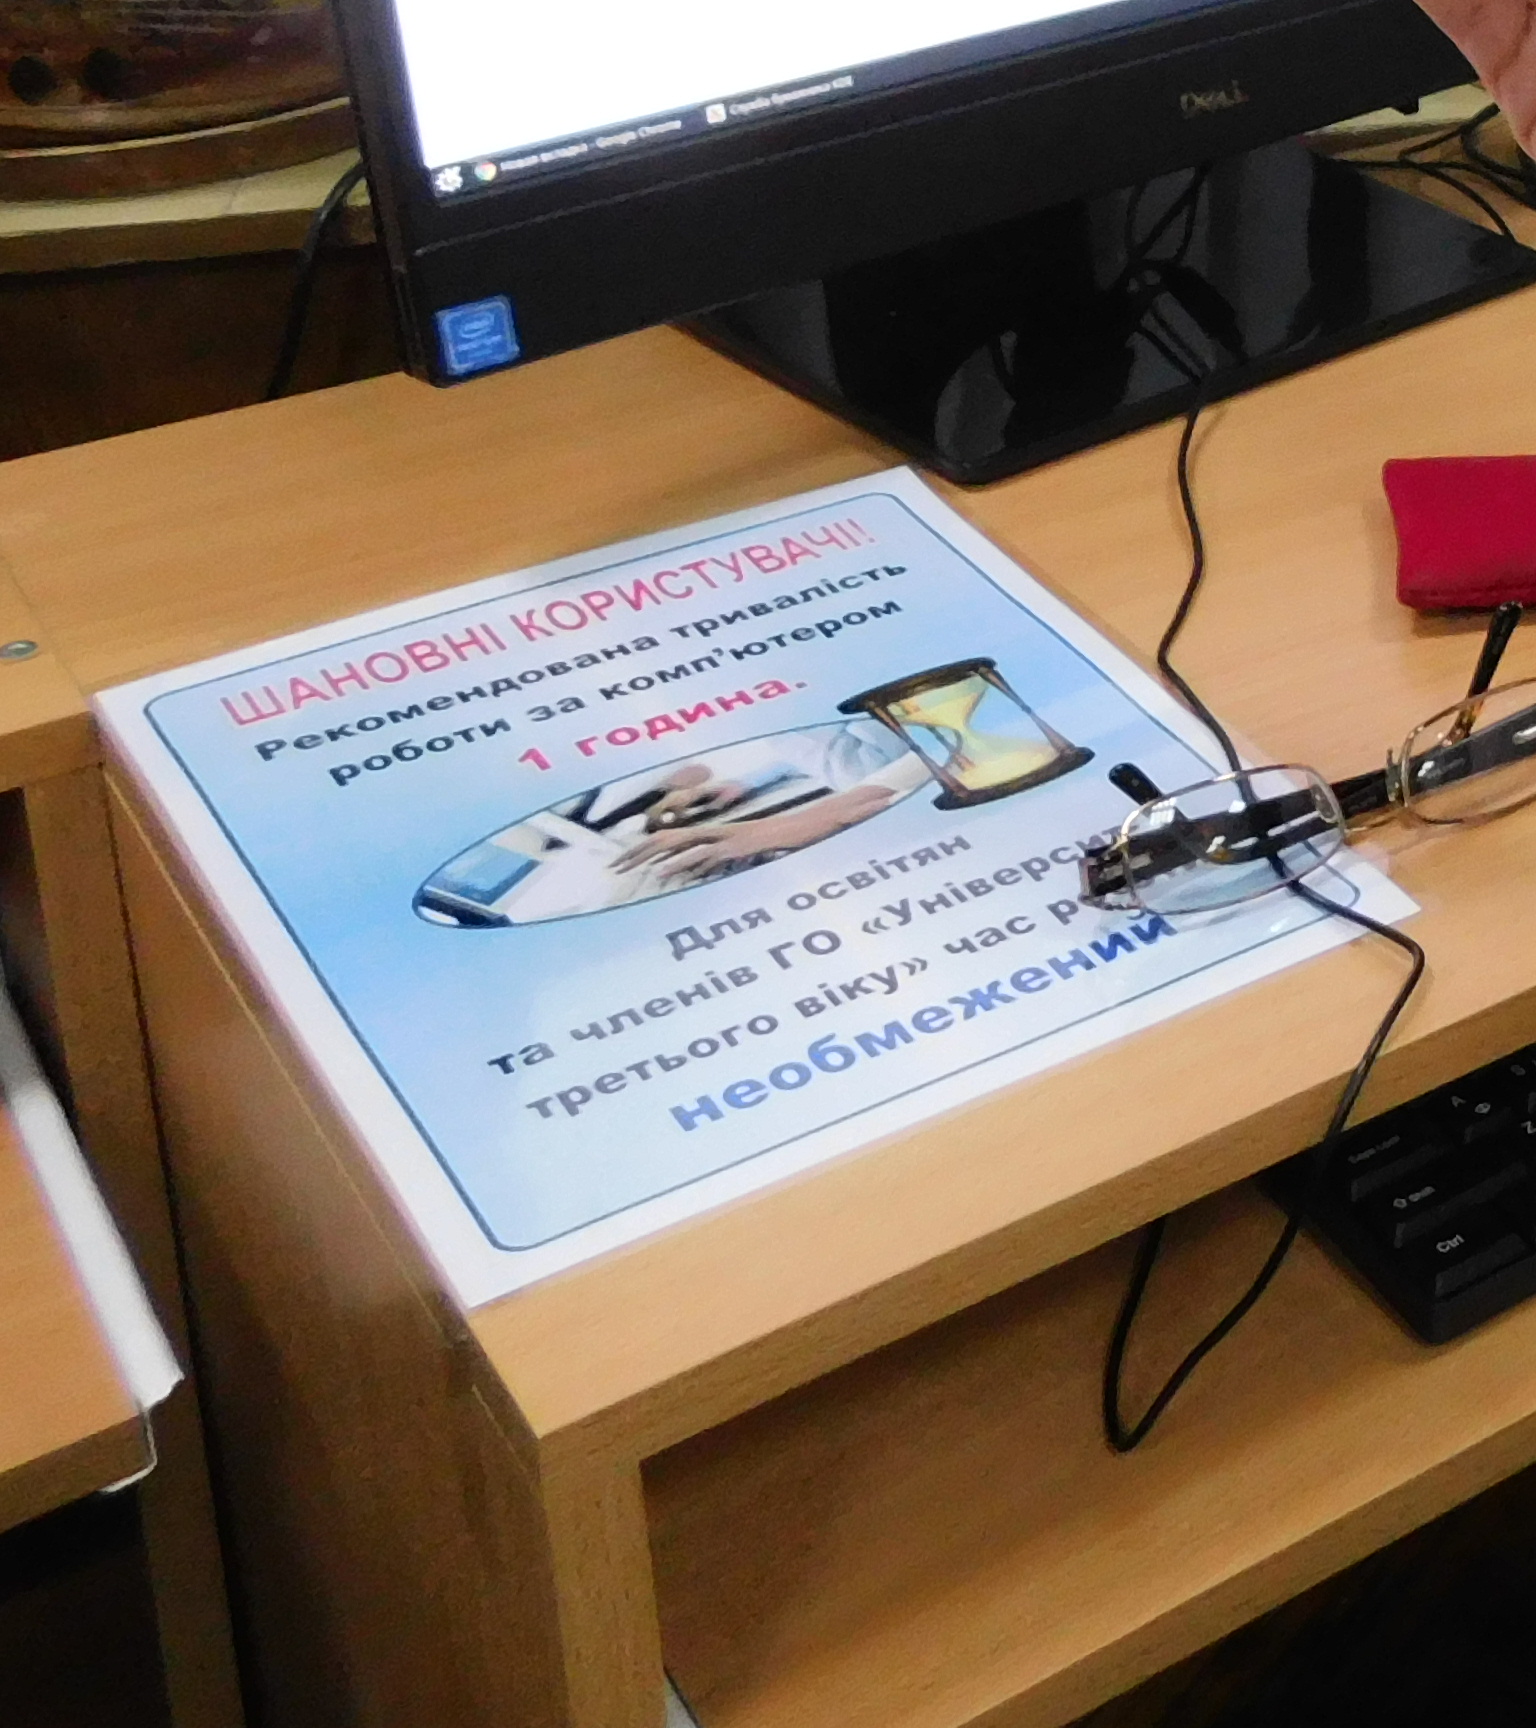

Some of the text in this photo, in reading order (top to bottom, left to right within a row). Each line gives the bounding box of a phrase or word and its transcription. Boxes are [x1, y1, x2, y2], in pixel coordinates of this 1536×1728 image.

[220, 623, 507, 725] ШАНОВНІ
[254, 563, 908, 761] Рекомендована тривалість
[517, 678, 808, 771] 1 година.
[327, 718, 512, 787] роботи
[526, 695, 587, 722] за
[665, 834, 973, 961] Для освітян
[486, 1041, 556, 1076] та
[569, 965, 760, 1042] членів
[767, 929, 843, 970] ГО
[525, 913, 1037, 1119] третього віку» час
[668, 908, 1177, 1132] необмежений
[1436, 1234, 1465, 1254] Ctrl
